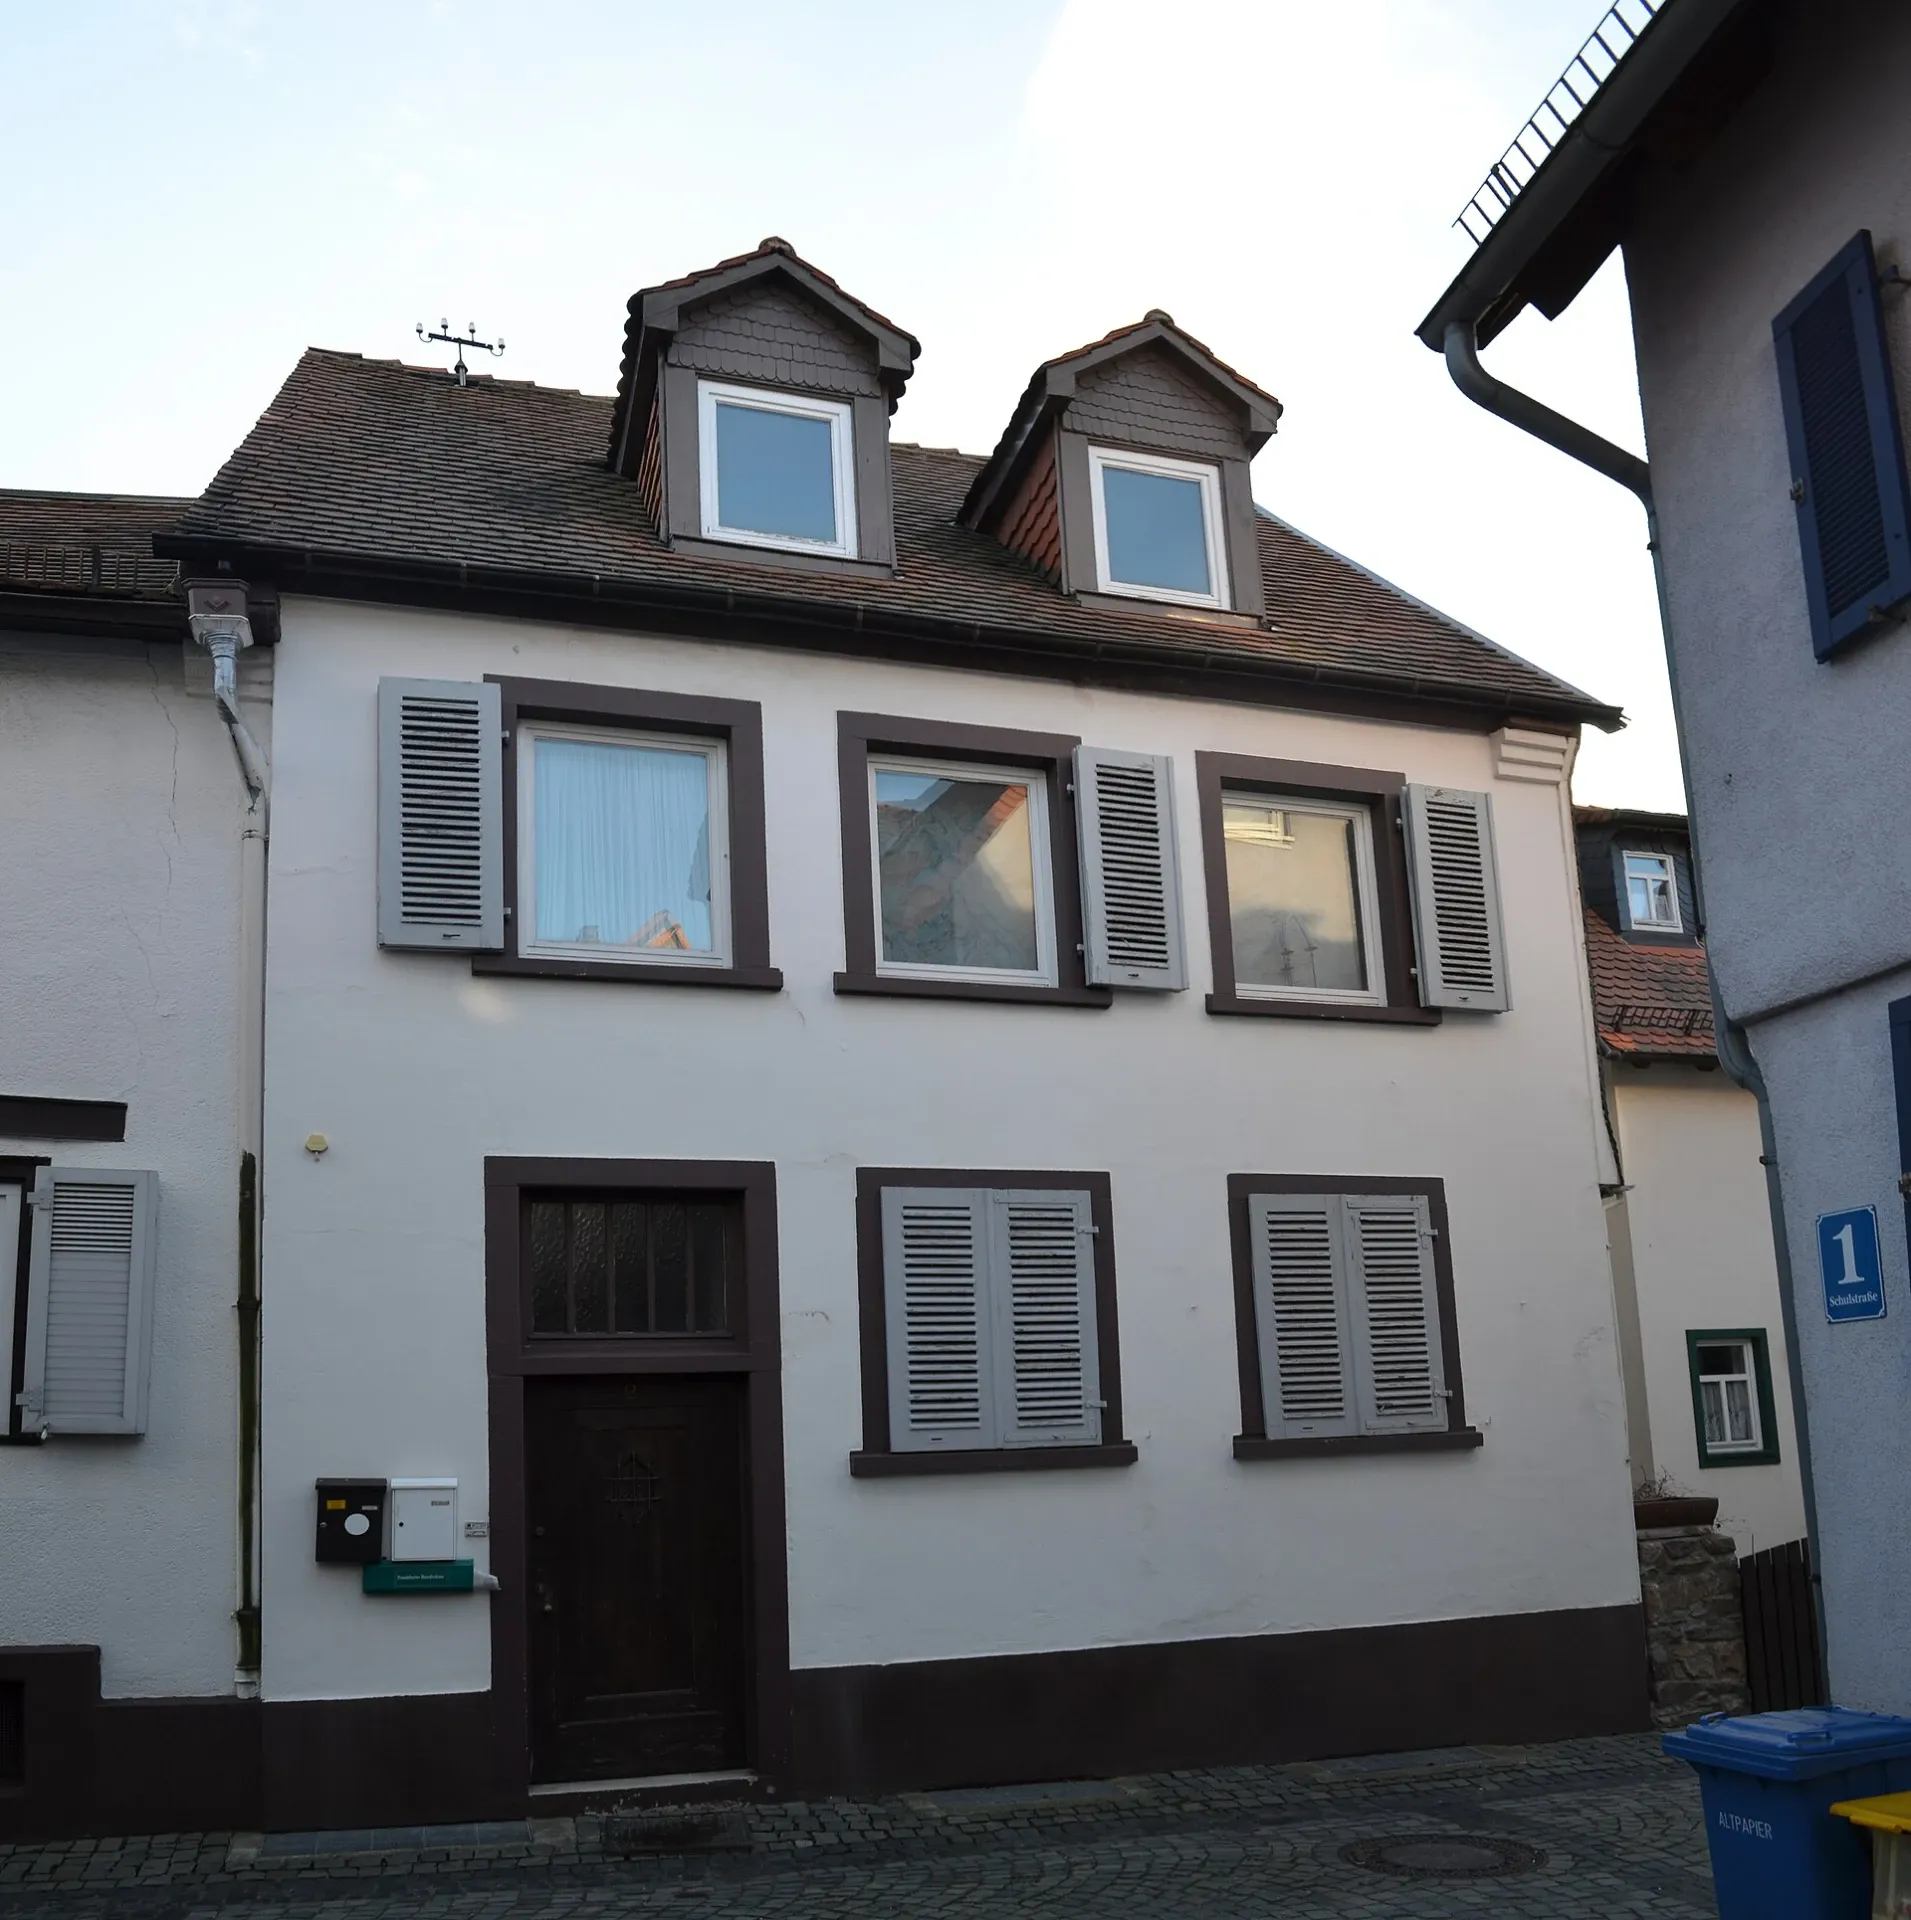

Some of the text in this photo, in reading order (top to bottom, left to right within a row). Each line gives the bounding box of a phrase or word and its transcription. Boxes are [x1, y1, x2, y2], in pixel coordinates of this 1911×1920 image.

[1832, 1224, 1865, 1285] 1
[1829, 1291, 1878, 1307] Schulstraße
[1718, 1811, 1773, 1841] ALTPAPIER
